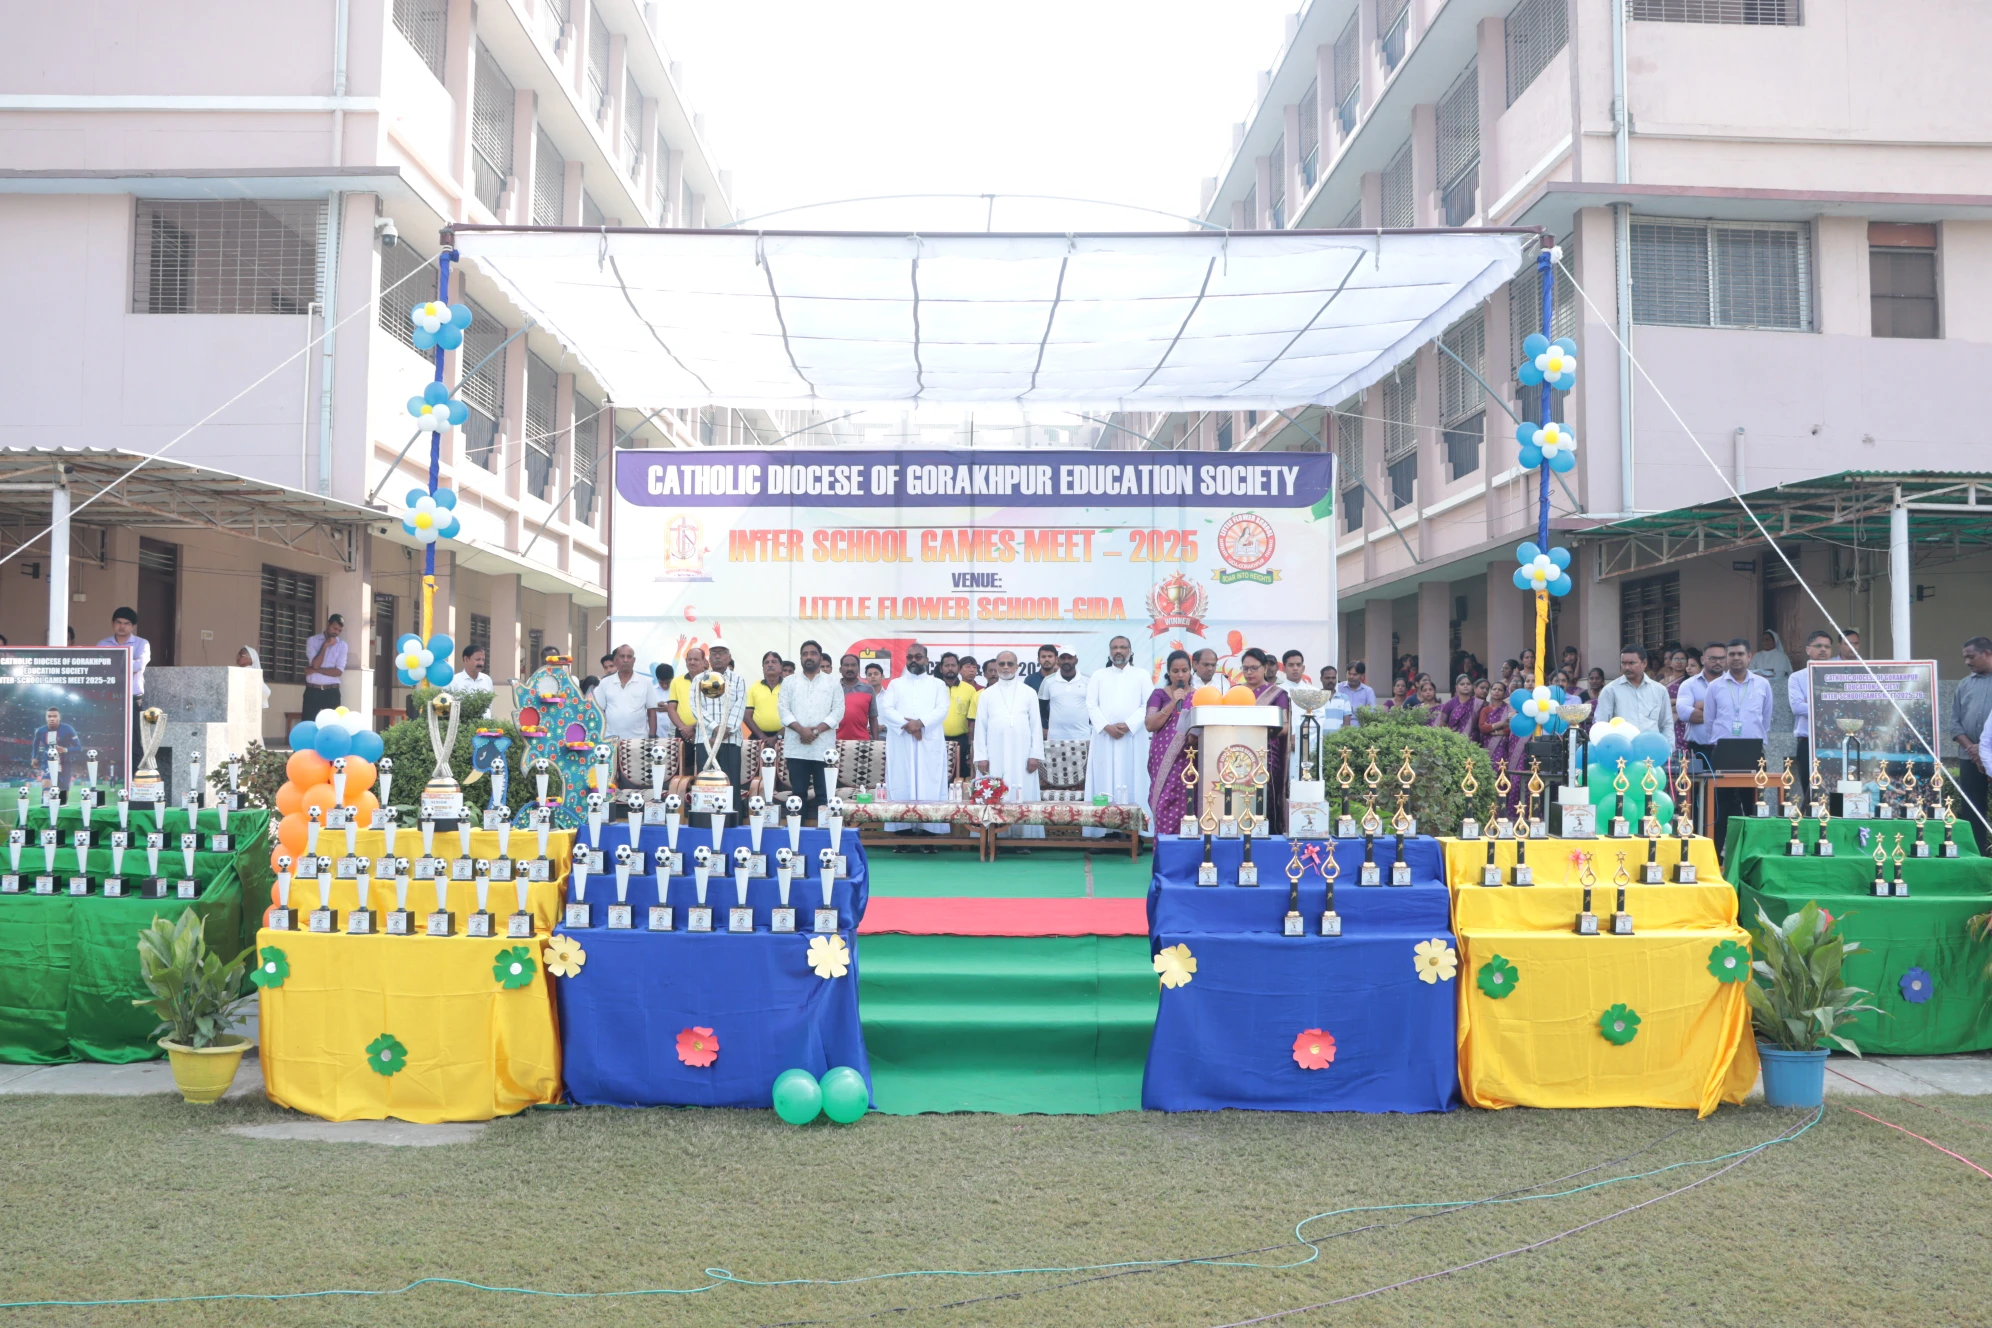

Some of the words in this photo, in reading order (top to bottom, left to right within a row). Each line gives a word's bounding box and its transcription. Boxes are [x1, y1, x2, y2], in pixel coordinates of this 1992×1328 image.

[648, 465, 761, 496] CATHOLIC
[767, 465, 864, 496] DIOCESE
[870, 465, 899, 496] OF
[906, 465, 1052, 496] GORAKHPUR
[1059, 465, 1193, 496] EDUCATION
[1200, 465, 1300, 496] SOCIETY
[1220, 517, 1235, 536] LITTLE
[1232, 514, 1256, 523] FLOWER
[1255, 517, 1274, 537] SCHOOL
[729, 529, 804, 562] INTER
[812, 529, 912, 562] SCHOOL
[921, 529, 1015, 562] GAMES
[1023, 529, 1095, 562] MEET
[1129, 529, 1198, 562] 2025
[951, 572, 1003, 588] VENUE:
[1222, 573, 1236, 582] SOAR
[1249, 573, 1272, 582] HEIGHTS
[799, 596, 871, 621] LITTLE
[877, 596, 970, 621] FLOWER
[977, 596, 1127, 621] SCHOOL-GIDA
[1165, 617, 1191, 626] WINNER
[0, 657, 33, 666] CATHOLIC
[33, 657, 62, 666] DIOCESE
[62, 657, 71, 666] OF
[71, 657, 112, 666] GORAKHPUR
[23, 667, 61, 675] EDUCATION
[61, 667, 89, 675] SOCIETY
[44, 676, 67, 685] GAMES
[67, 676, 85, 685] MEET
[1824, 674, 1852, 682] CATHOLIC
[1844, 683, 1875, 691] EDUCATION
[1876, 683, 1900, 691] SCIETY
[1863, 692, 1881, 700] GAMES
